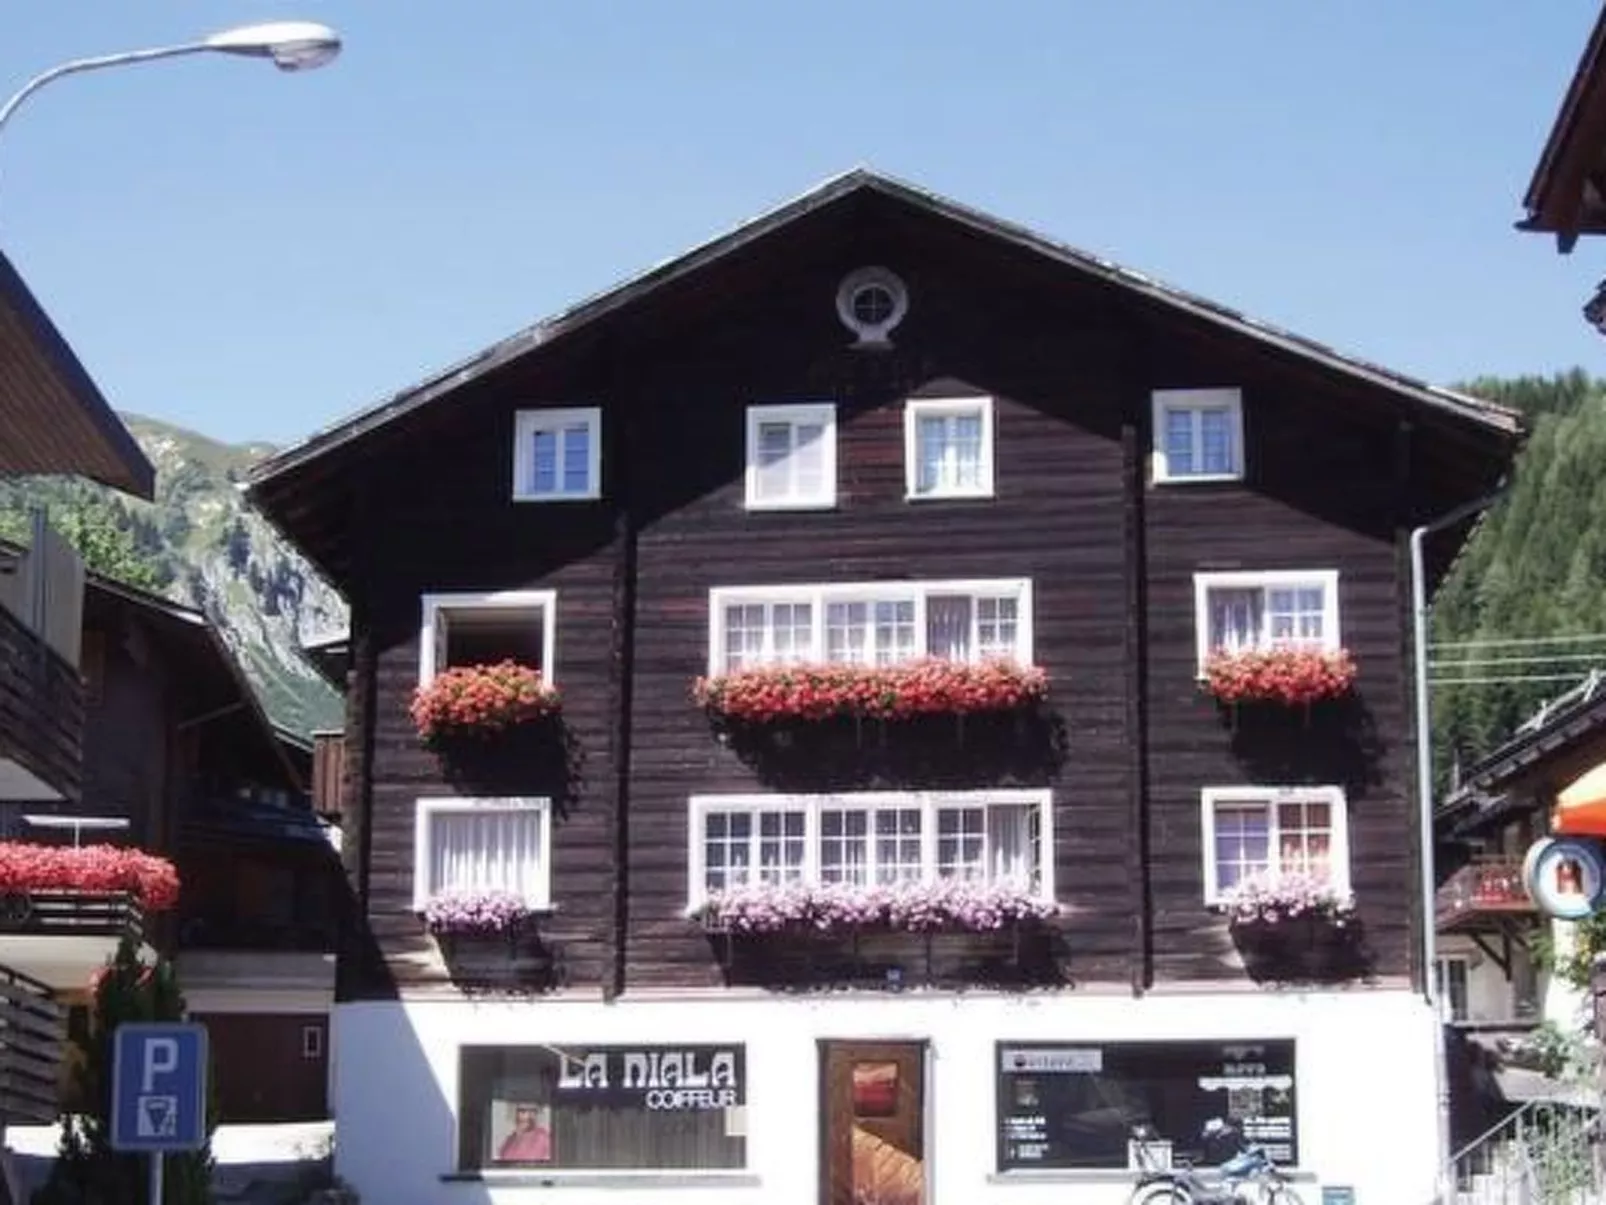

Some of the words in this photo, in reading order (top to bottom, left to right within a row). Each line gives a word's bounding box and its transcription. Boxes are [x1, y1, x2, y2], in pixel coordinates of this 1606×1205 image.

[142, 1038, 179, 1092] P
[558, 1052, 609, 1088] LA
[623, 1052, 736, 1088] NIALA
[646, 1089, 736, 1109] COIFFEUR
